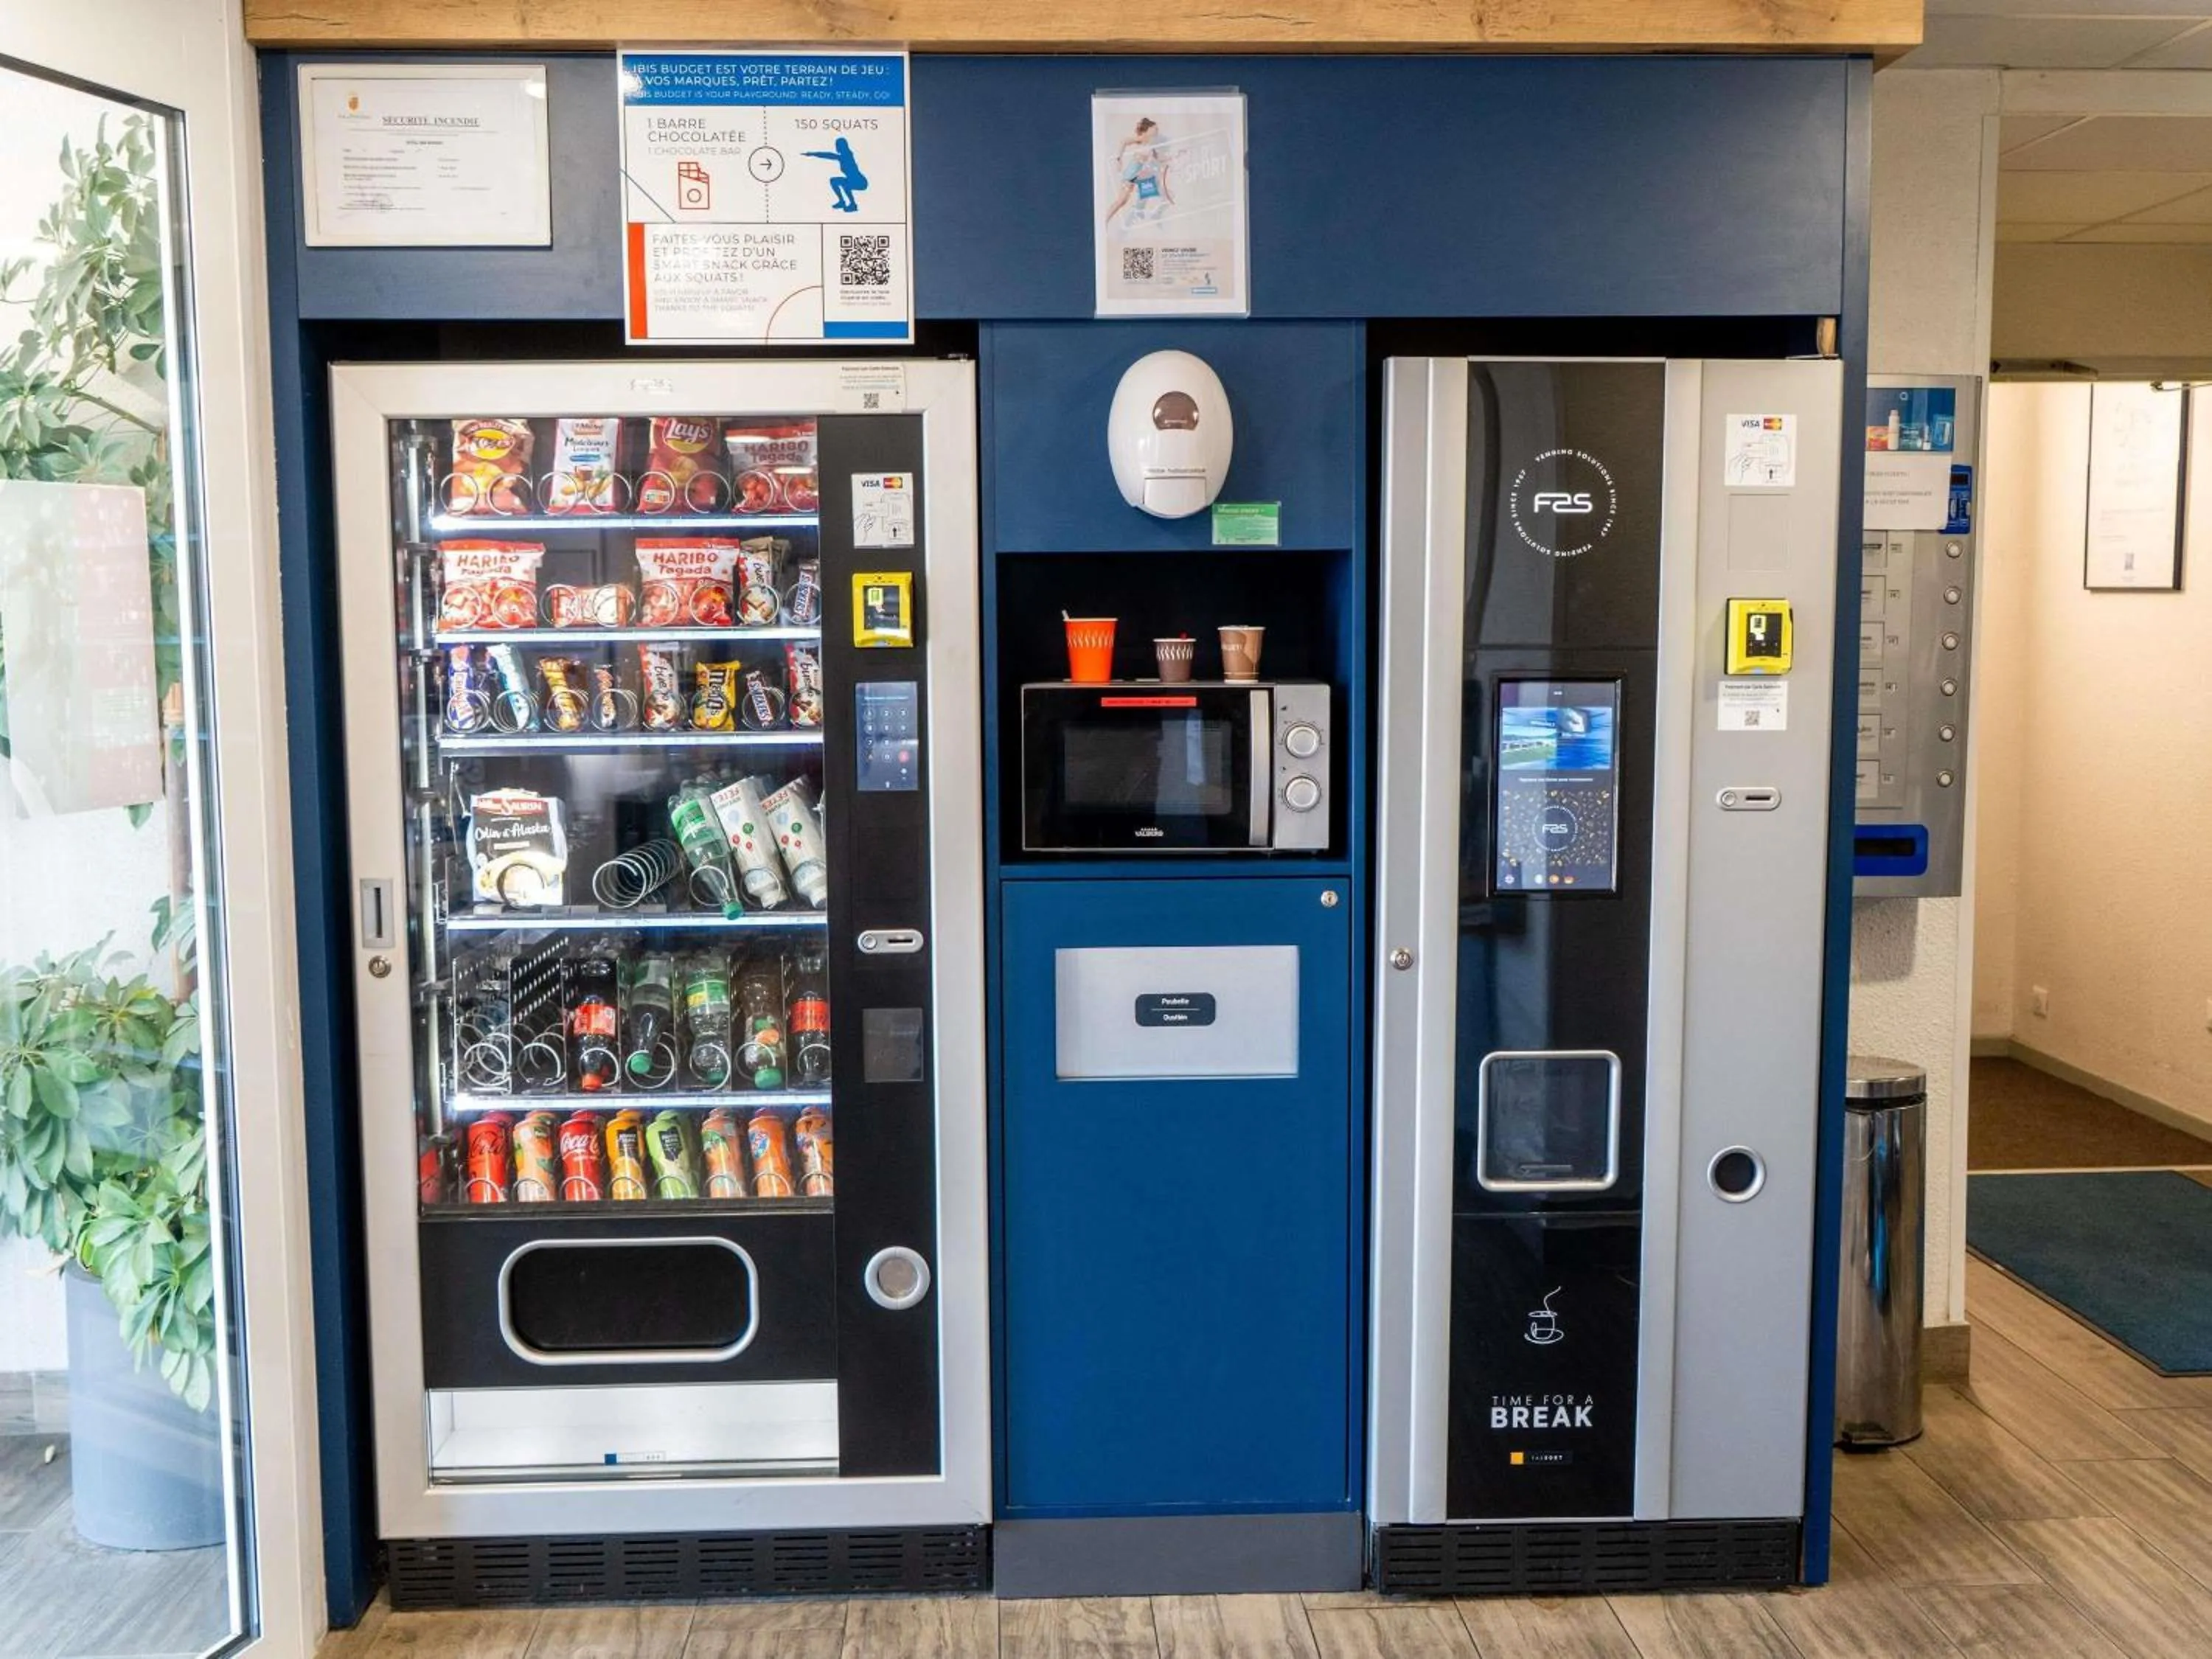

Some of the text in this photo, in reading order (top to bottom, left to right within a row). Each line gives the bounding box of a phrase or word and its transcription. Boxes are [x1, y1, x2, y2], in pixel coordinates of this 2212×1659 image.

[661, 65, 712, 74] BUDGET
[715, 65, 737, 74] EST
[740, 65, 781, 74] VOTRE
[784, 65, 837, 74] TERRAIN
[841, 65, 858, 74] DE
[645, 76, 670, 86] VOS
[674, 76, 740, 88] MARQUES,
[655, 91, 692, 99] BUDGET
[694, 91, 703, 99] IS
[706, 91, 731, 99] YOUR
[647, 118, 706, 129] 1 BARRE
[795, 119, 879, 131] 150 SQUATS
[647, 130, 746, 142] CHOCOLATÉE
[654, 147, 718, 156] CHOCOLATE
[720, 147, 741, 155] BAR
[744, 234, 795, 245] PLAISIR
[653, 247, 667, 257] ET
[742, 247, 776, 257] D'UN
[701, 260, 748, 271] SNACK
[751, 259, 797, 271] GRÂCE
[744, 440, 809, 455] HARIBO
[752, 451, 804, 465] Tagada
[653, 552, 718, 564] HARIBO
[658, 564, 712, 577] Tagada
[1492, 1395, 1593, 1406] TIME FOR A
[1490, 1405, 1593, 1428] BREAK
